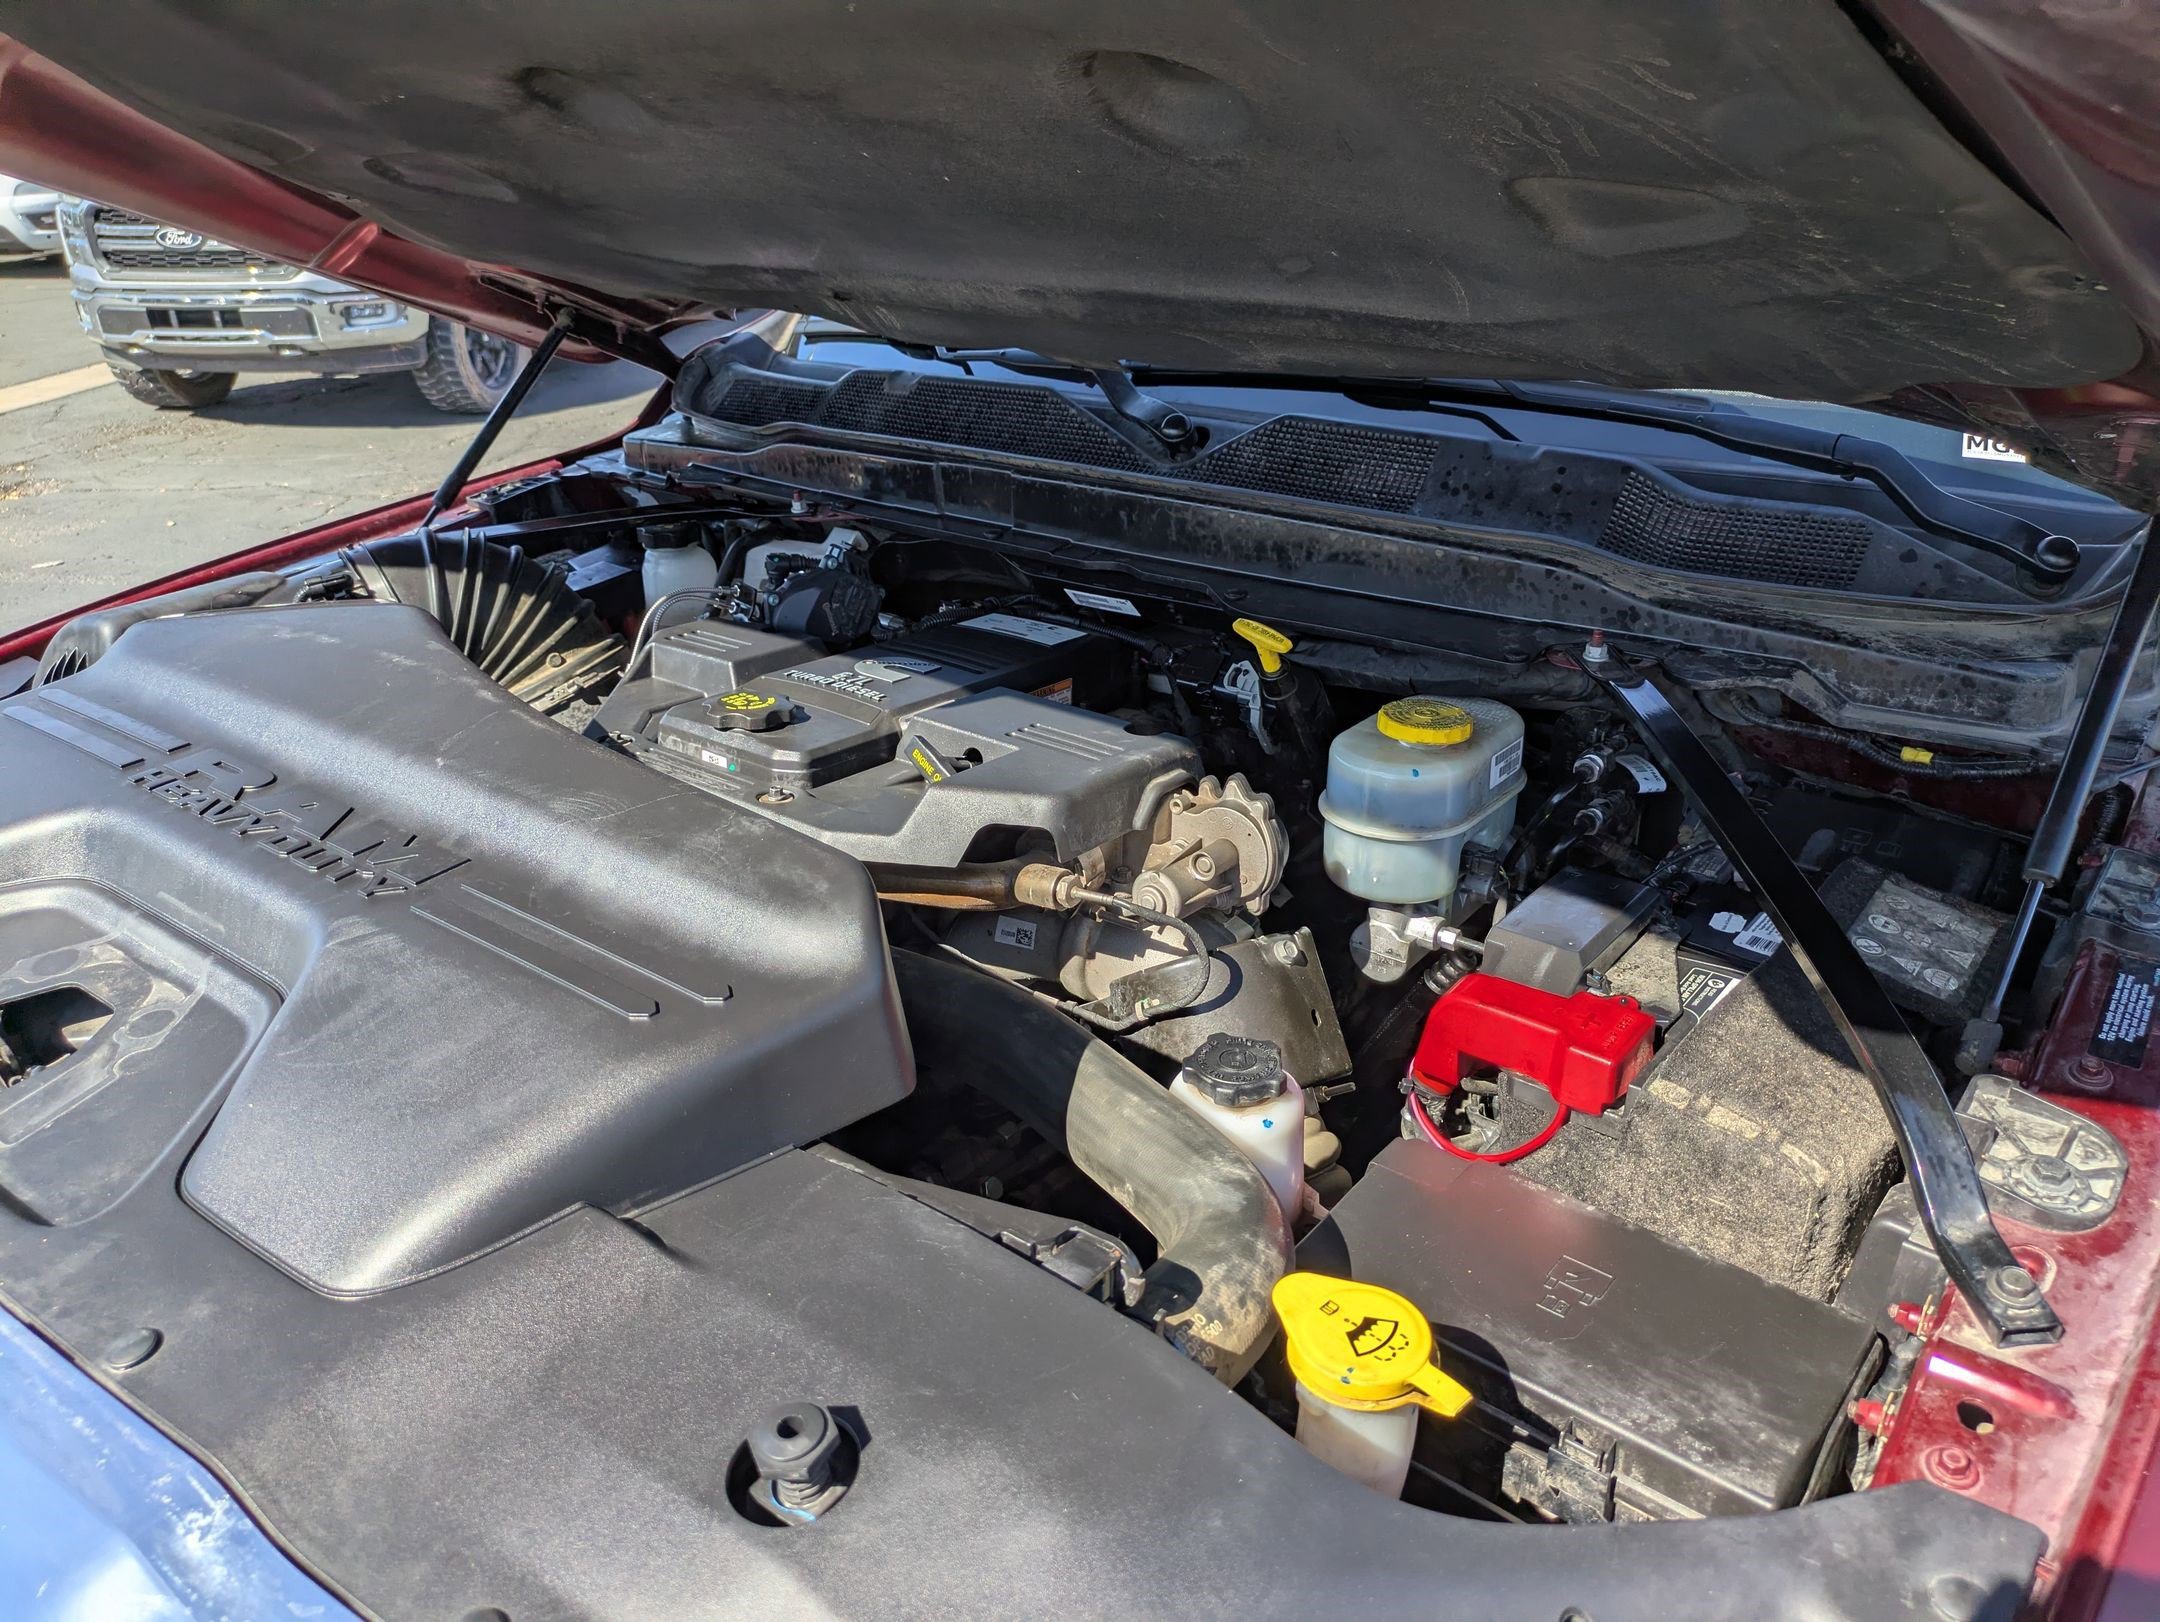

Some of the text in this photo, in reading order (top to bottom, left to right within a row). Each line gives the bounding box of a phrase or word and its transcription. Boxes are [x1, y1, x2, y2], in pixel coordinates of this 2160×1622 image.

[165, 230, 192, 245] Ford
[783, 669, 887, 702] TURBO DIESEL
[912, 748, 935, 776] ENGINE
[128, 768, 408, 898] HEAVY DUTY
[162, 749, 472, 887] RAM
[2106, 1031, 2116, 1041] 12V
